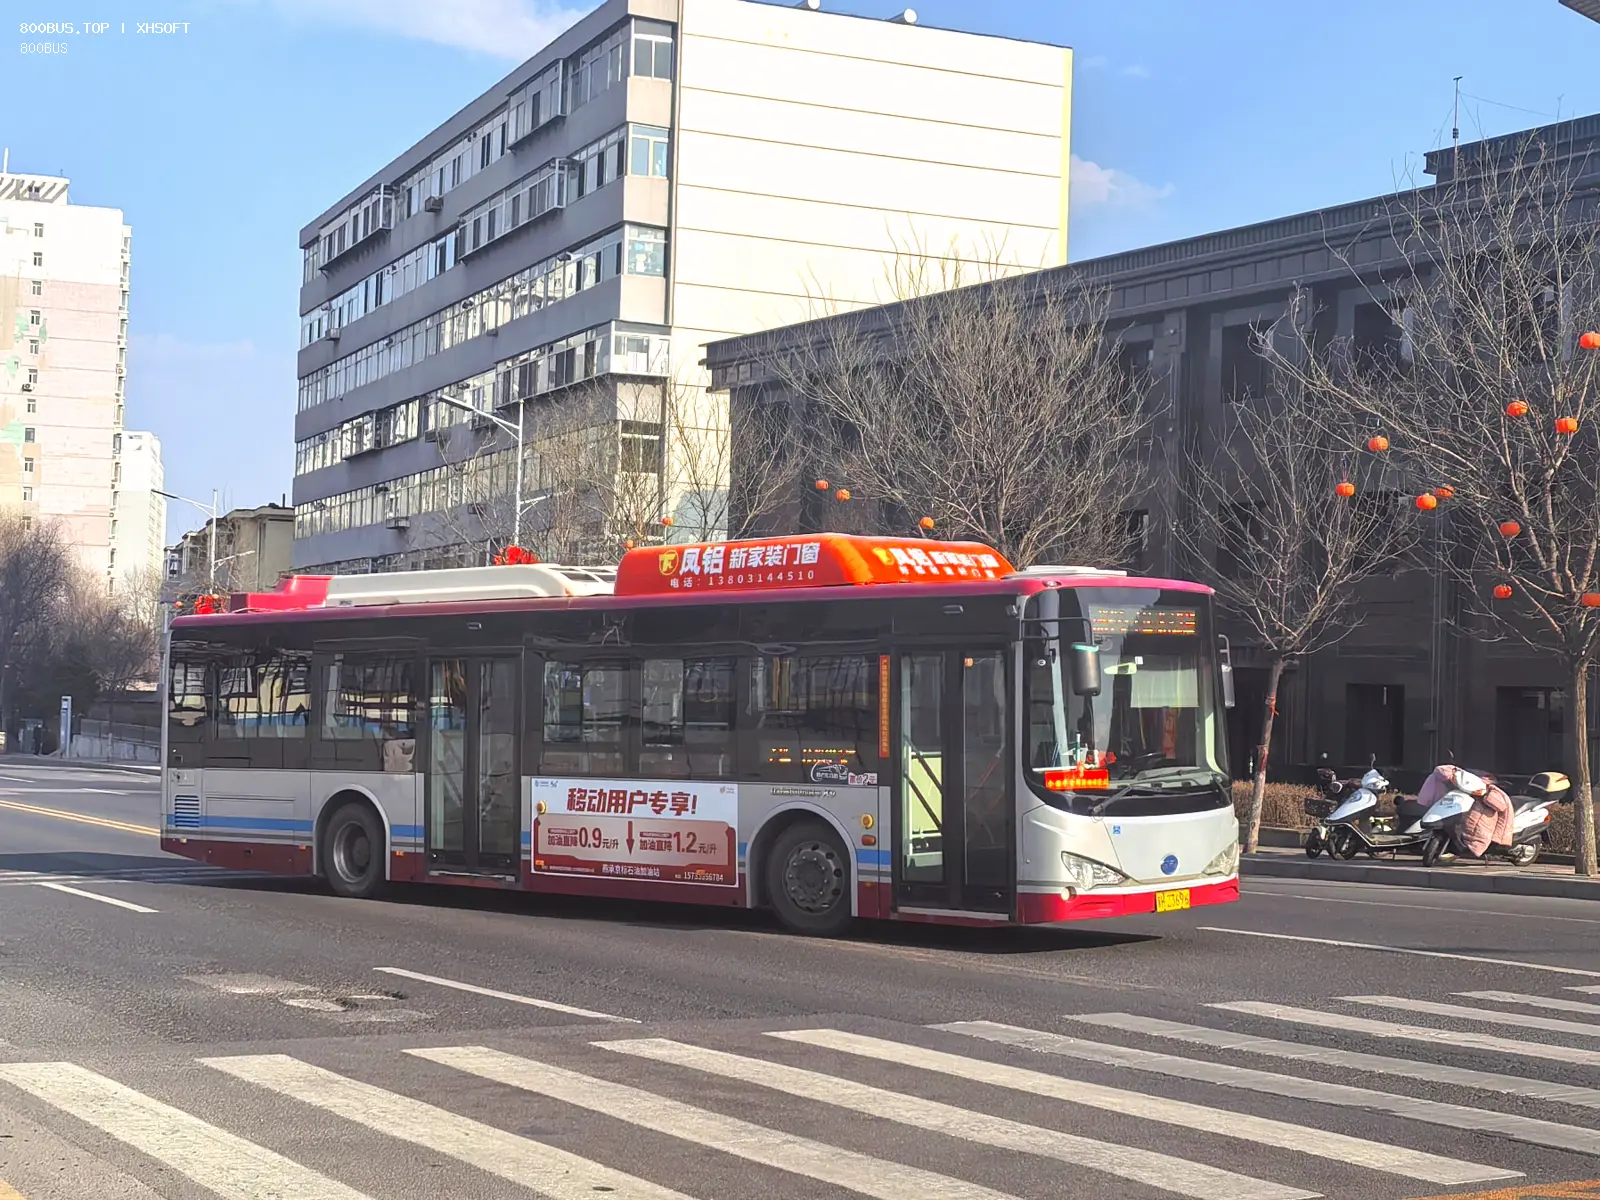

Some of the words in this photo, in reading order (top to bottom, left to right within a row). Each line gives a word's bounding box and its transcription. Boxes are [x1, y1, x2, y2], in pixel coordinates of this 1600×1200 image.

[679, 546, 726, 575] 凤铝
[728, 542, 821, 569] 新家装门窗
[708, 570, 815, 586] 13803144510
[567, 787, 698, 816] 移动用户专享！
